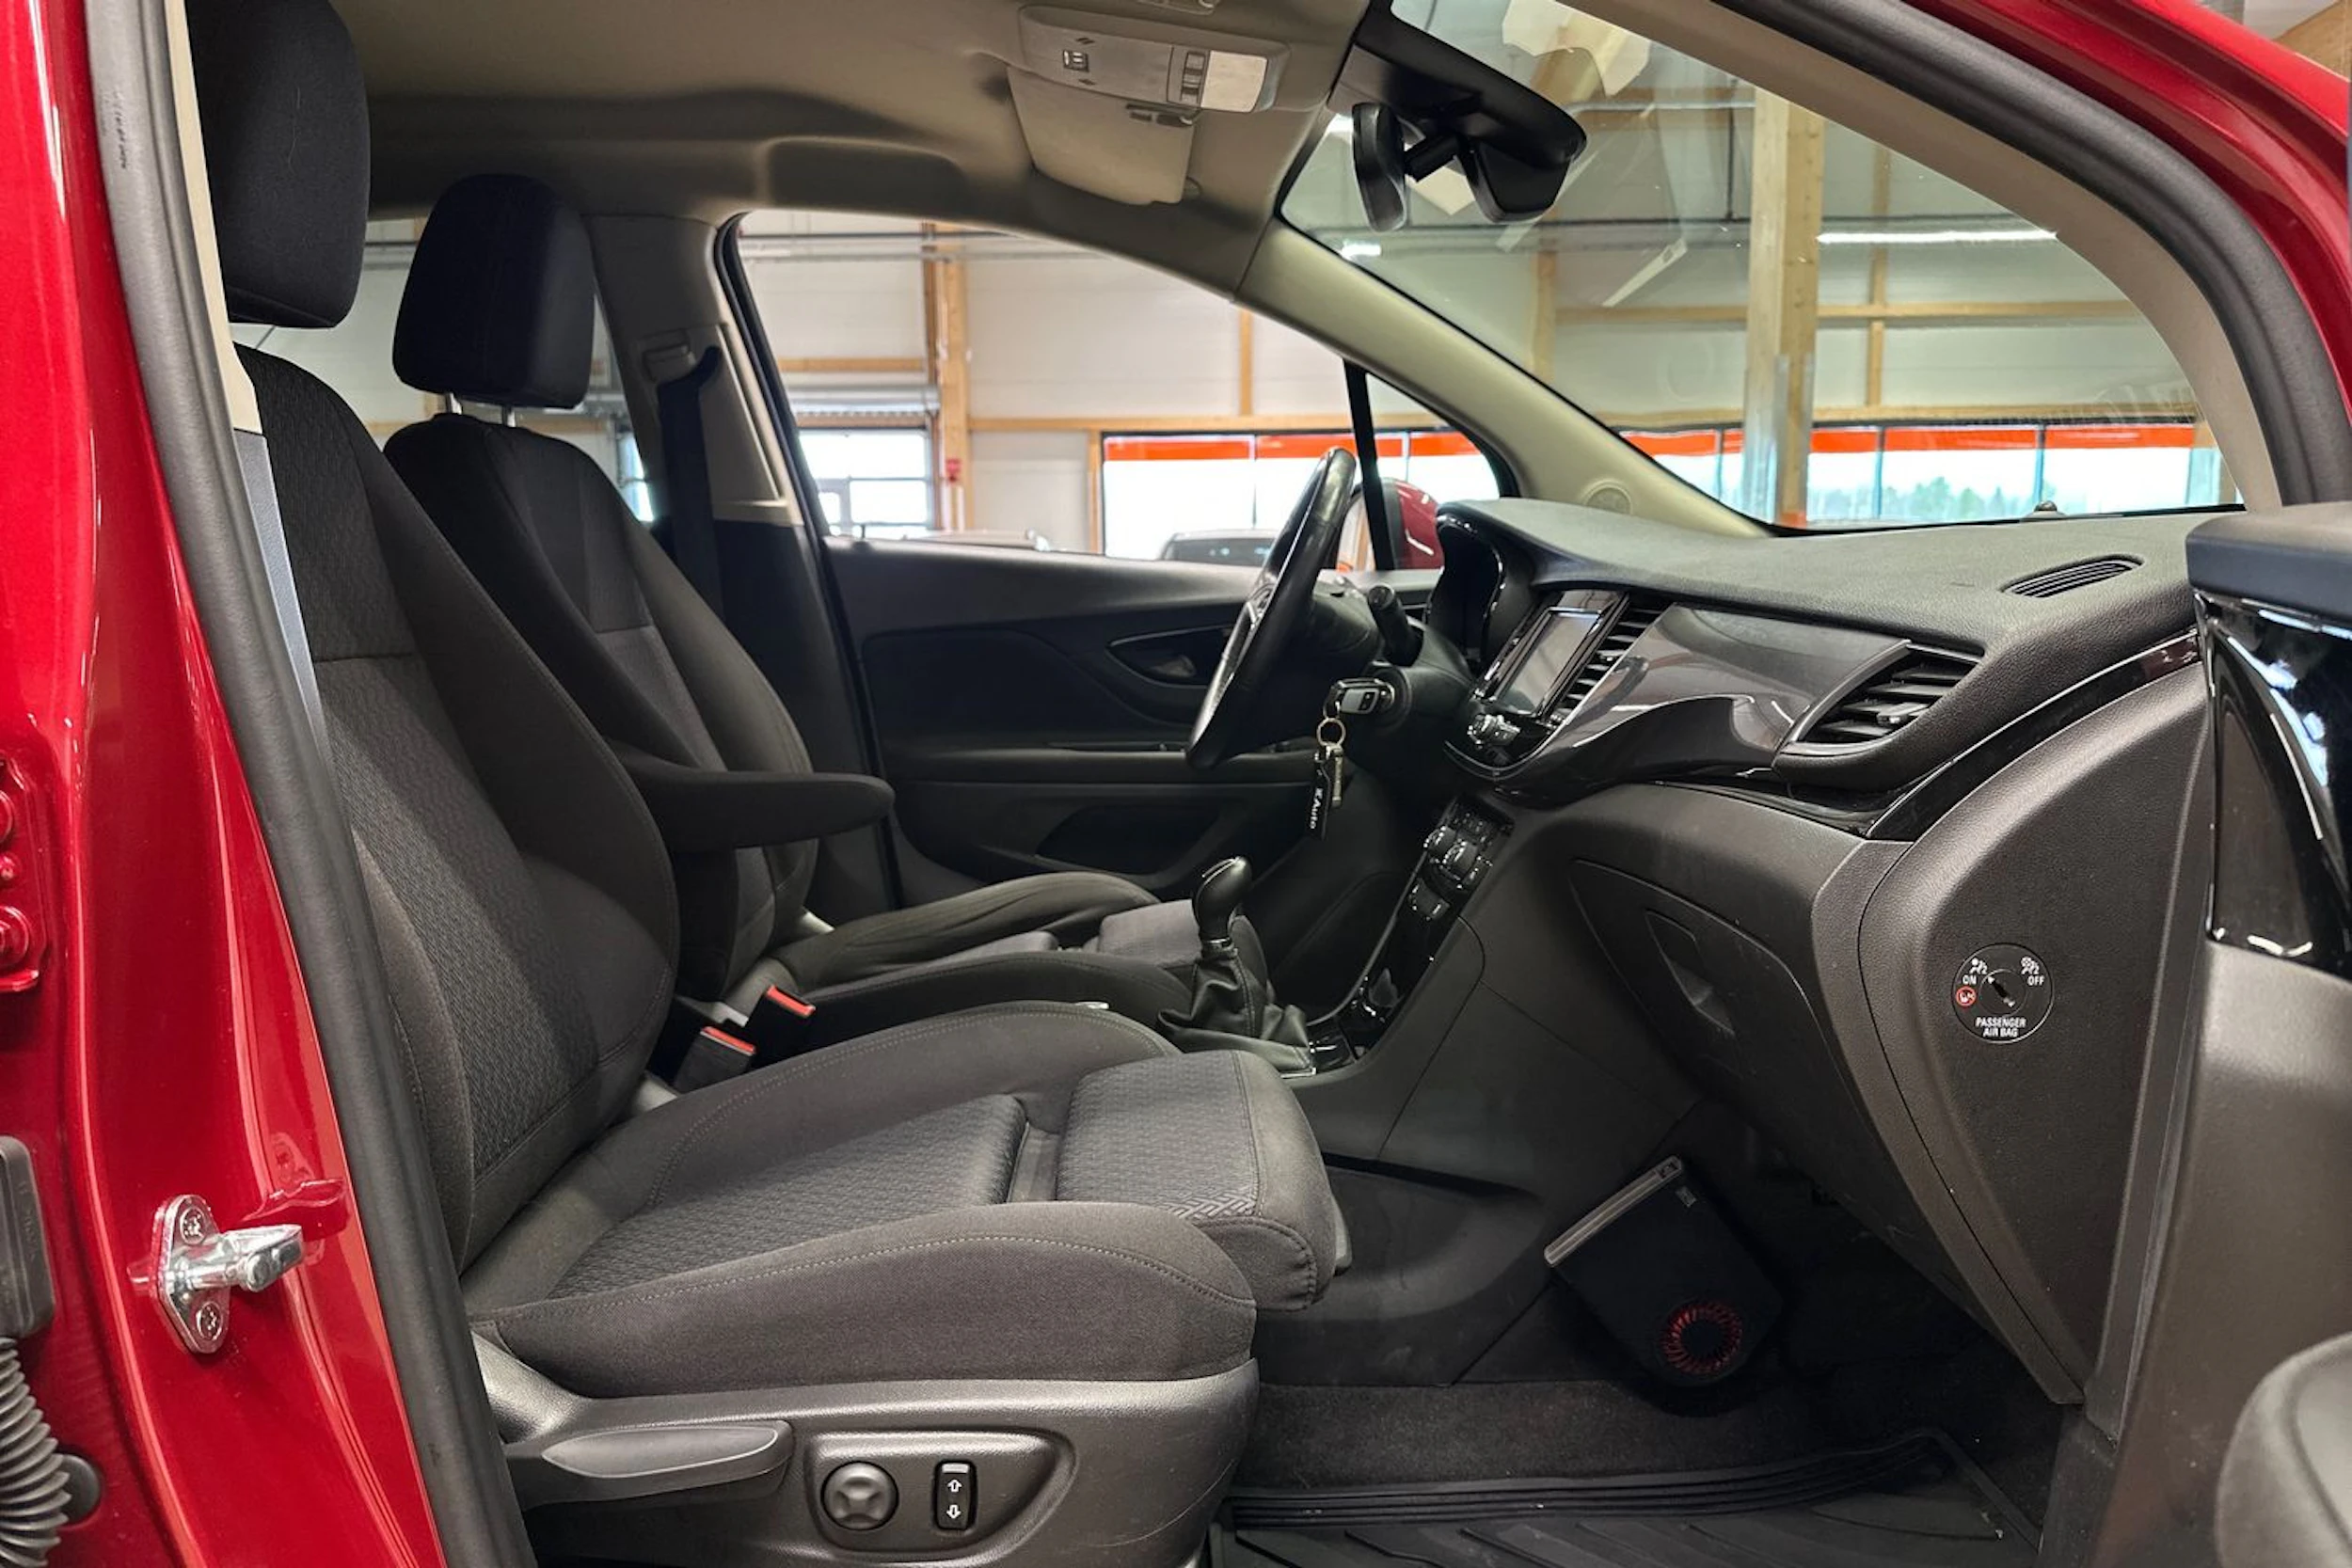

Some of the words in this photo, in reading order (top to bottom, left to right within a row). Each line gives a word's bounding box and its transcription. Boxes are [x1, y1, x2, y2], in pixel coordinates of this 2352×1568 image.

[1963, 974, 1977, 985] ON
[2027, 975, 2044, 986] OFF
[1976, 1017, 2026, 1028] PASSENGER
[1982, 1028, 1998, 1037] AIR
[2000, 1028, 2018, 1037] BAG
